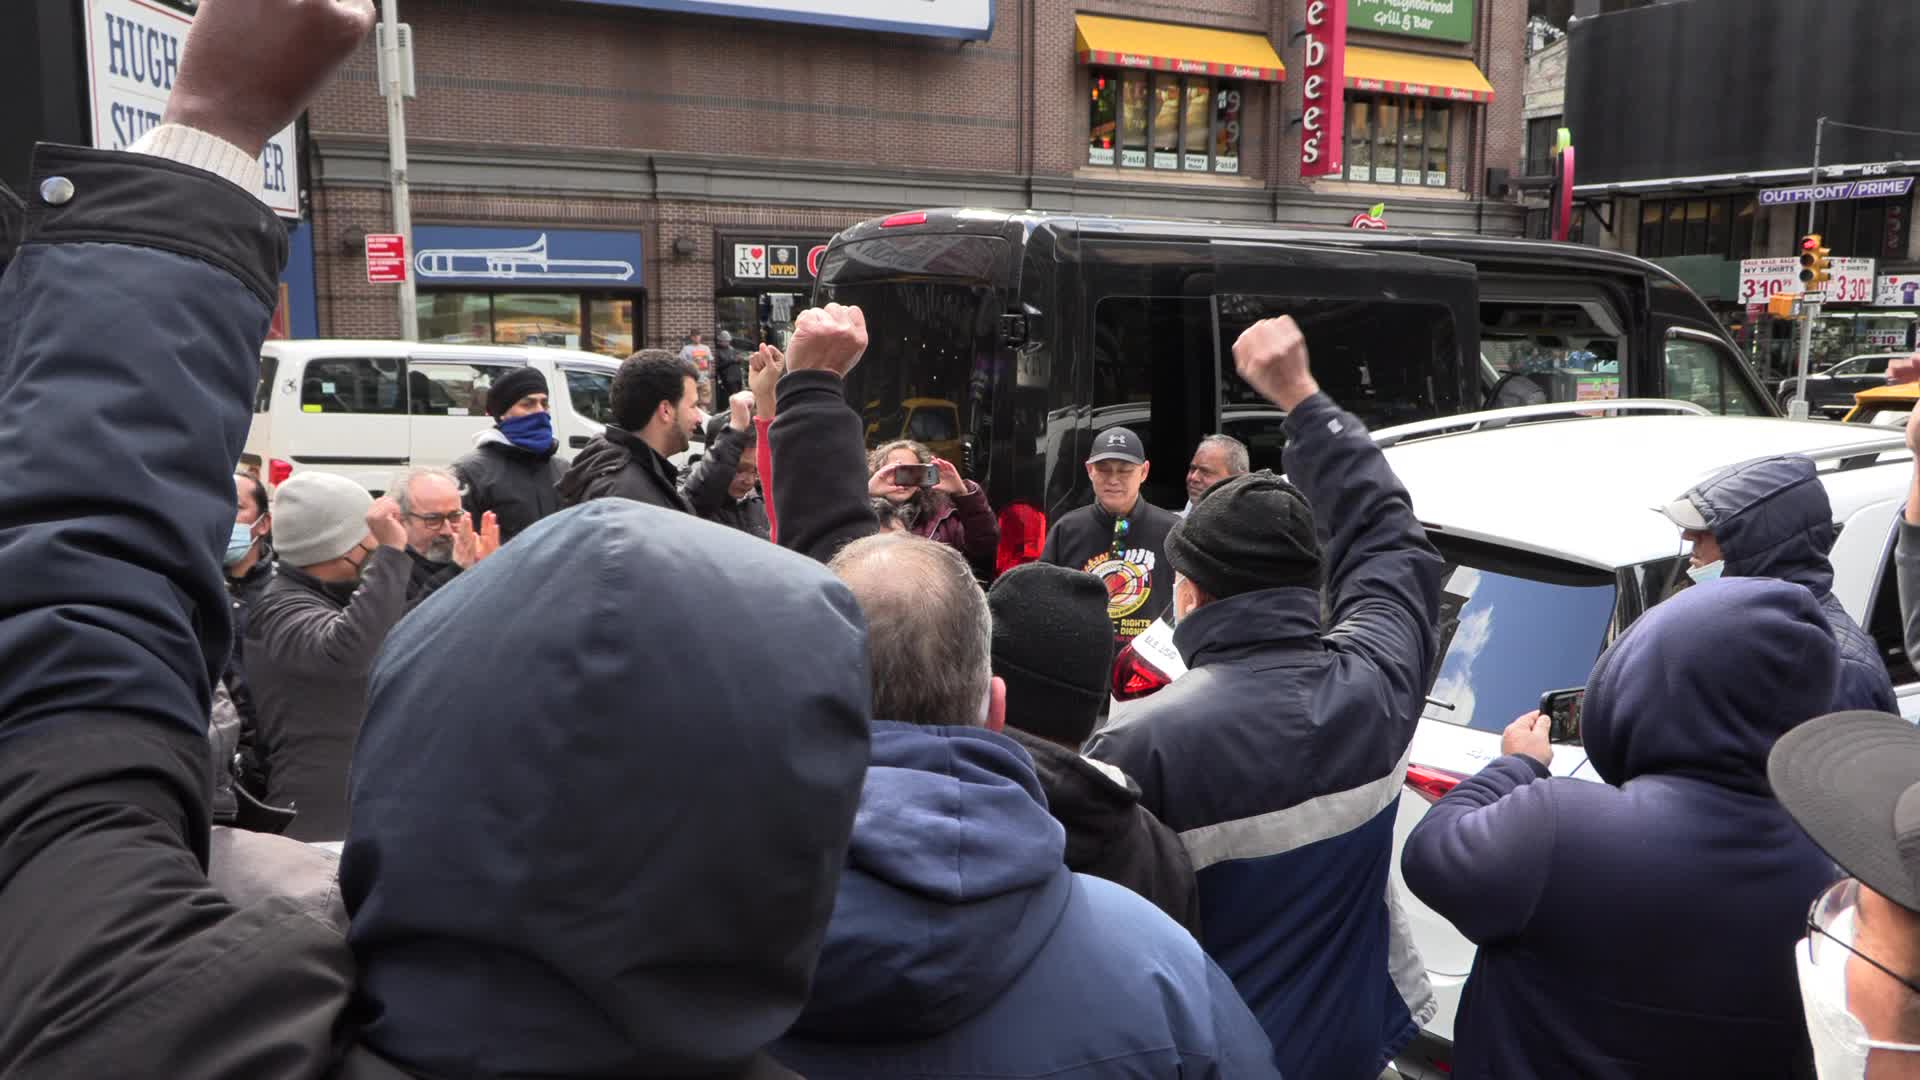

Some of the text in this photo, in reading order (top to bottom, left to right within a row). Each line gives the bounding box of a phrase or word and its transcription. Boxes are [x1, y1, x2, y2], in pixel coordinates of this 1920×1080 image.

[1374, 10, 1401, 26] Grill
[1413, 16, 1433, 30] Bar
[105, 12, 178, 90] HUGH
[1763, 180, 1905, 203] OUTFRONT PRIME
[739, 262, 763, 275] NY
[769, 264, 796, 275] NYPD
